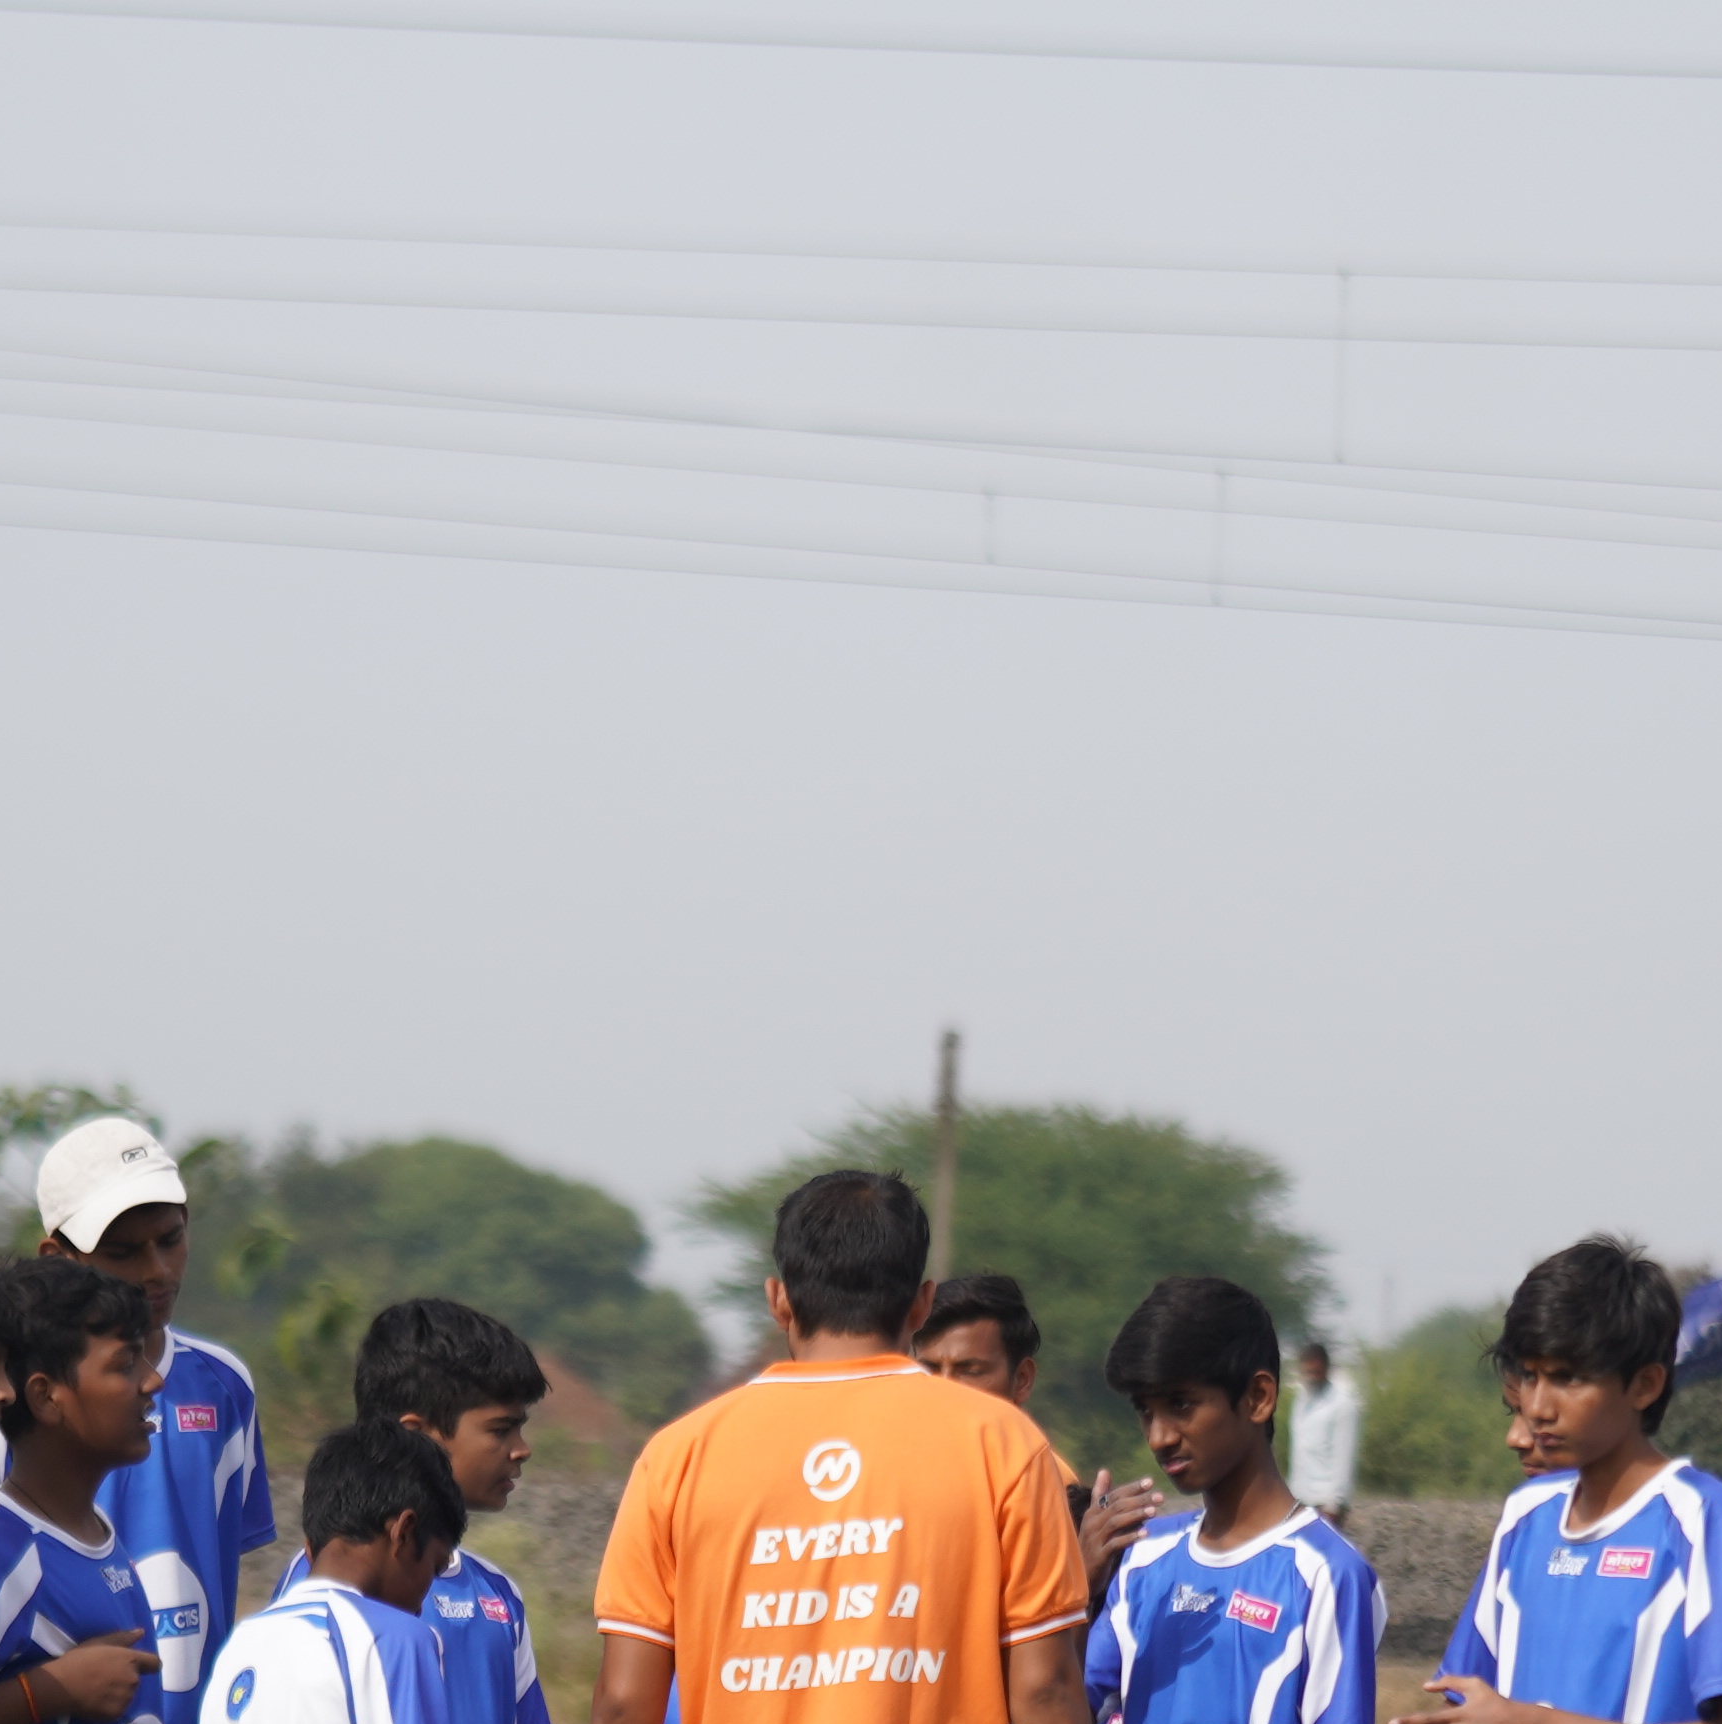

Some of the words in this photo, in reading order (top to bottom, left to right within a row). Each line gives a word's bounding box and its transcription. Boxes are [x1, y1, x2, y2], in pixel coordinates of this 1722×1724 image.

[749, 1518, 904, 1565] EVERY
[741, 1591, 828, 1629] KID
[834, 1584, 878, 1621] IS
[888, 1585, 920, 1618] A
[721, 1647, 947, 1693] CHAMPION
